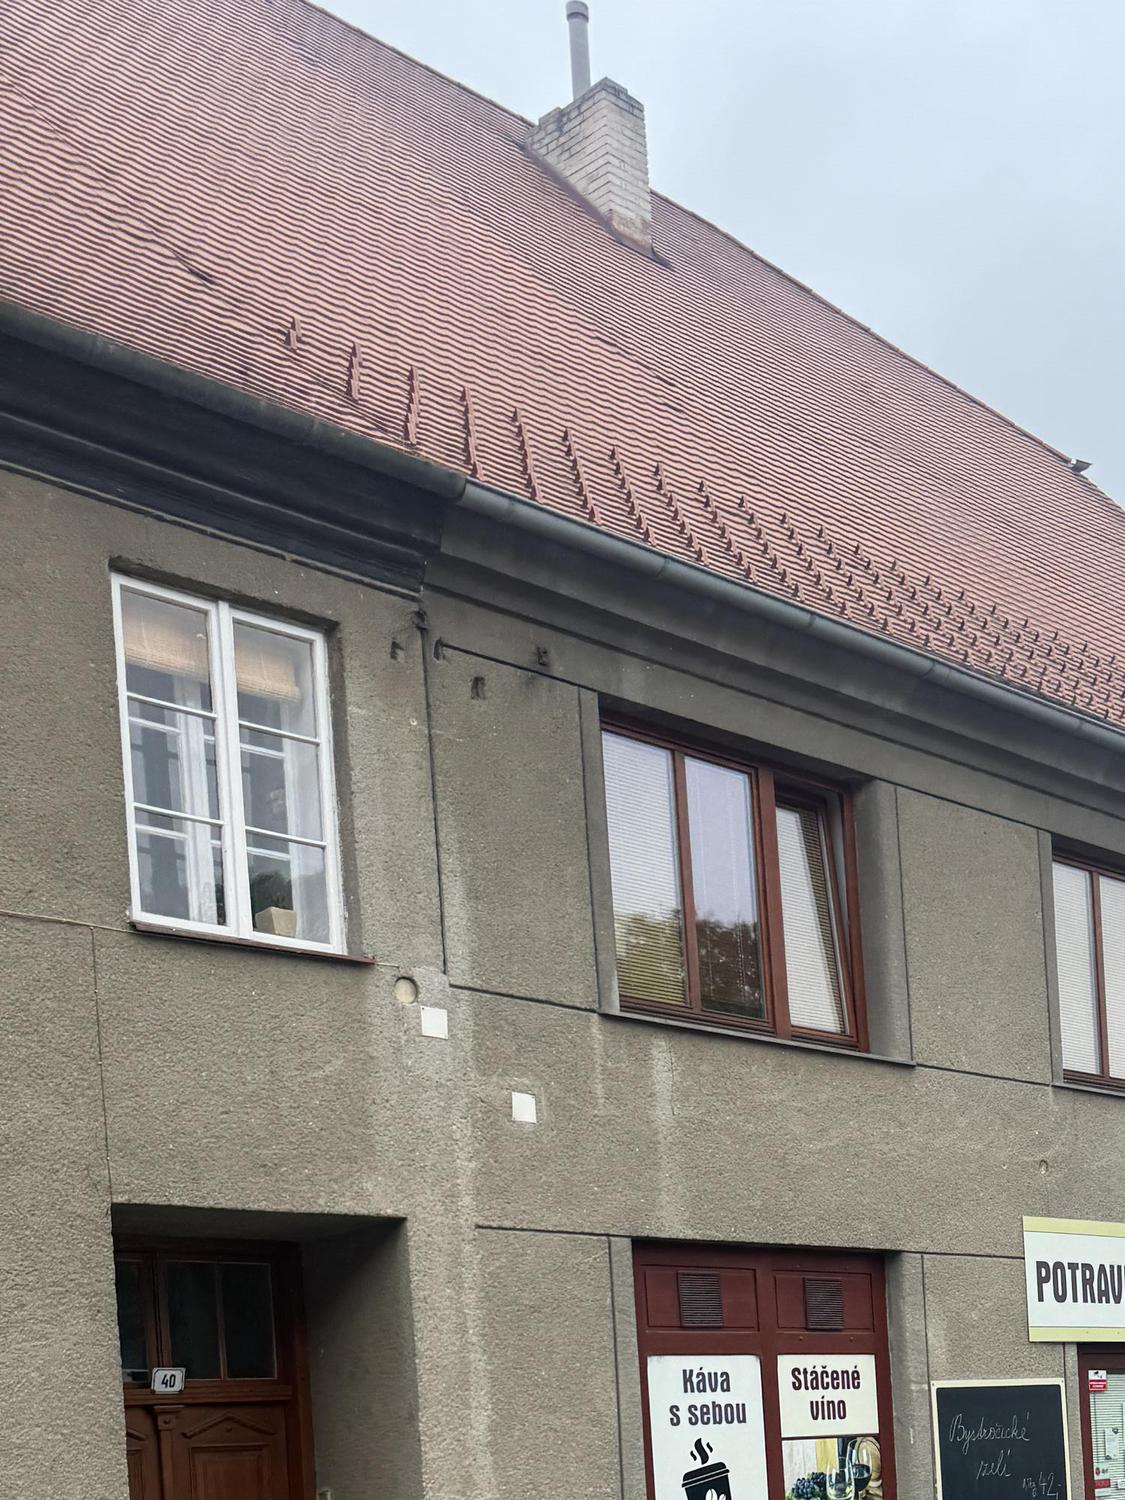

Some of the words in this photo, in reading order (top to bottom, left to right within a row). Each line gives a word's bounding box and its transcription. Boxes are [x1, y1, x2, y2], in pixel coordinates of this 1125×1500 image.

[161, 1374, 176, 1388] 40
[682, 1366, 731, 1394] Káva
[791, 1364, 861, 1391] Stáčené
[669, 1405, 681, 1427] s
[688, 1401, 747, 1426] sebou
[809, 1394, 847, 1421] víno
